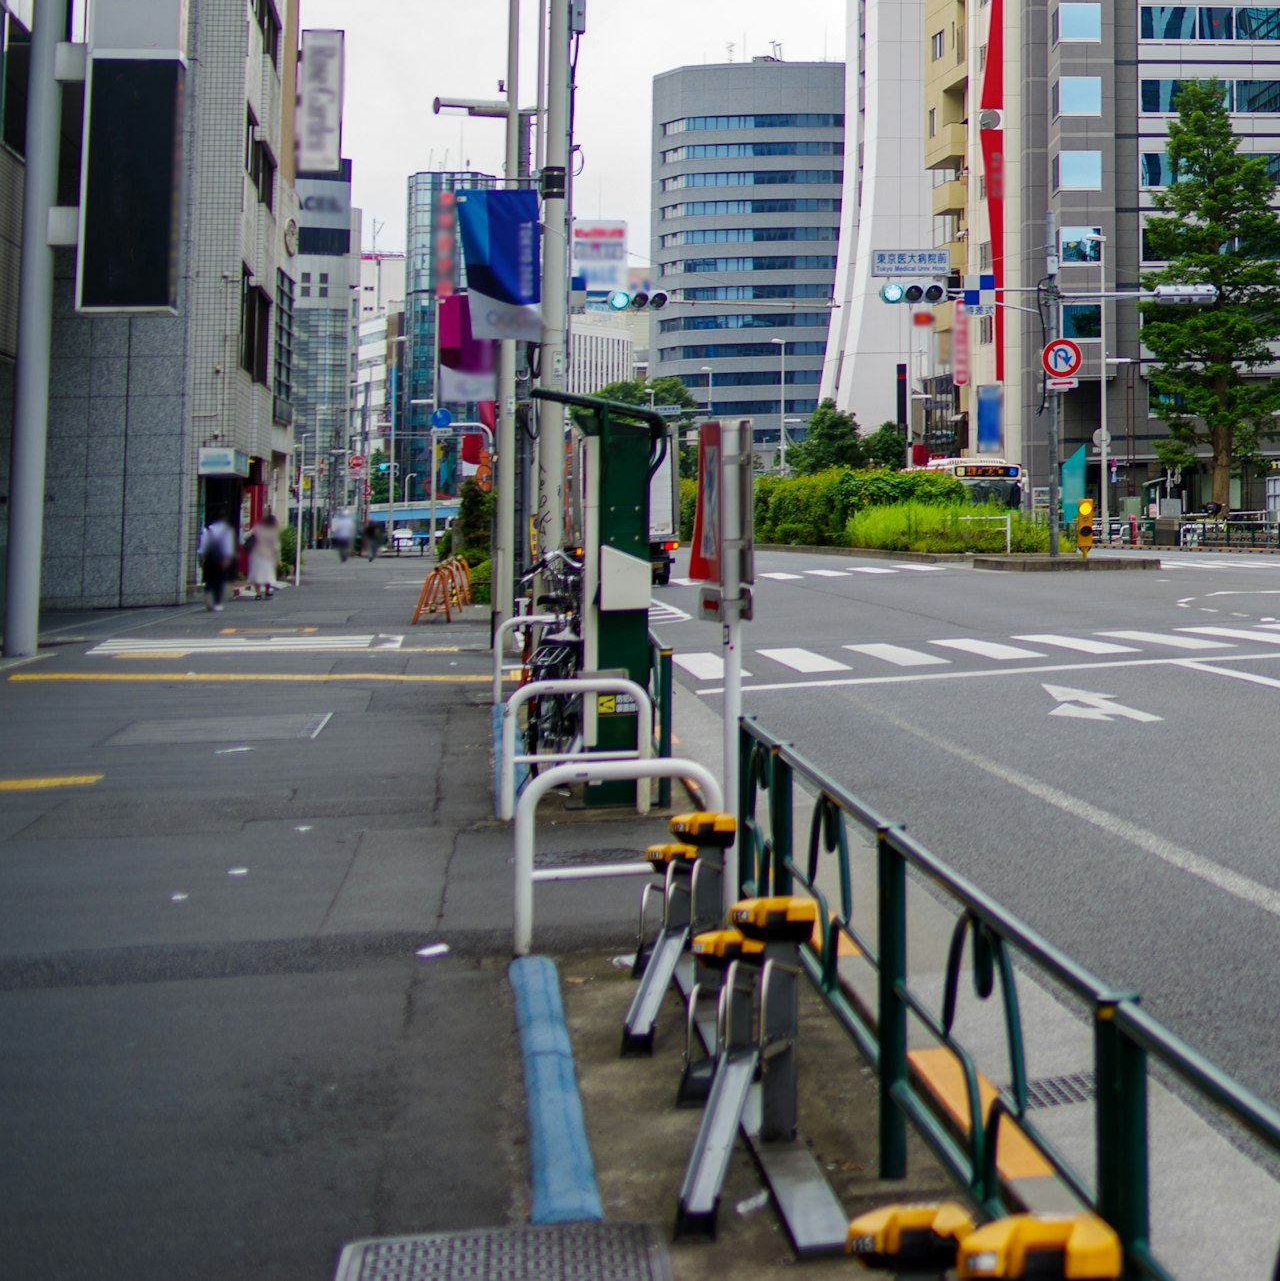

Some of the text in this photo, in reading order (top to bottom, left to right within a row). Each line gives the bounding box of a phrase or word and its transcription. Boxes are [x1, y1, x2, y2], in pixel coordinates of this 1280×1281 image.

[876, 253, 947, 264] 東京医大病院前
